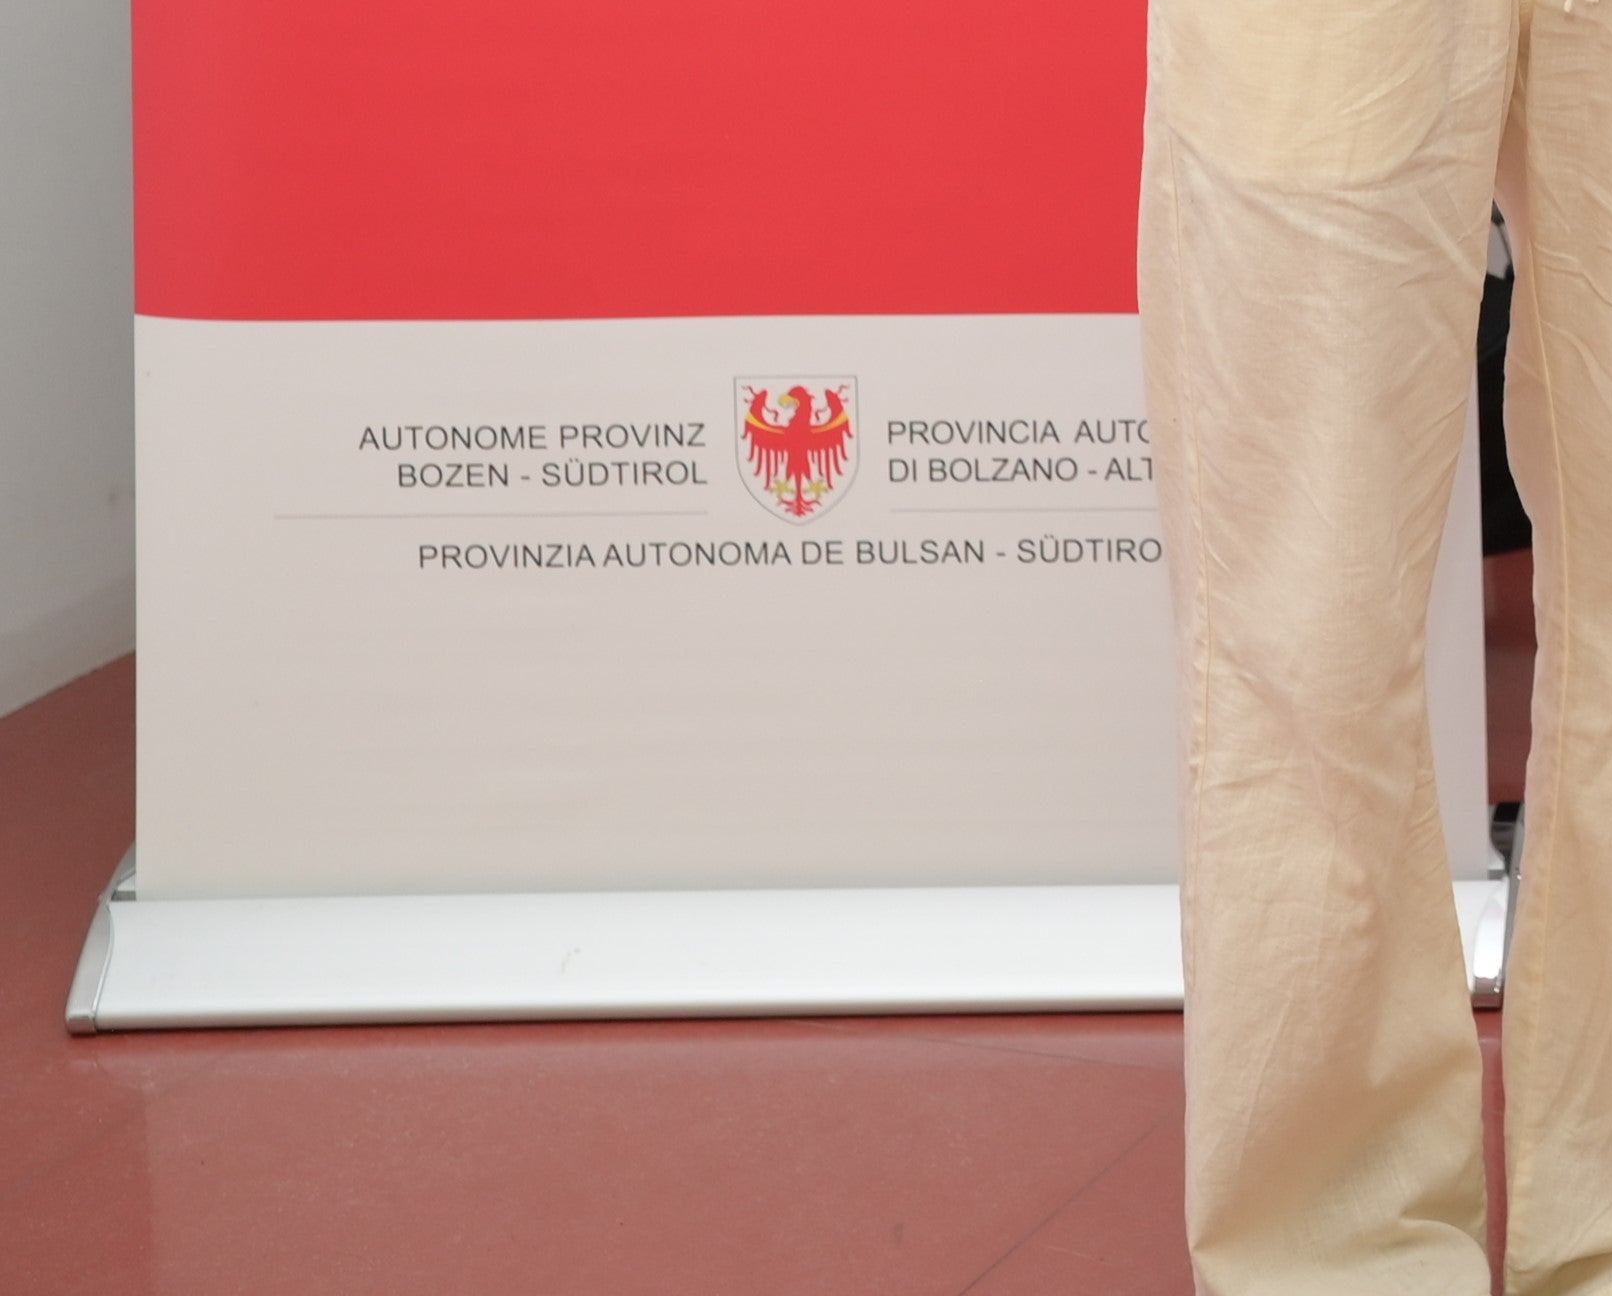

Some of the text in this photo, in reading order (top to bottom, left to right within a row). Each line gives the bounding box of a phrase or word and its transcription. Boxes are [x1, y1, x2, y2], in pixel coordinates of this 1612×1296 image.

[359, 423, 706, 451] AUTONOME PROVINZ
[888, 419, 1060, 445] PROVINCIA
[399, 463, 509, 488] BOZEN
[541, 458, 708, 486] SÜDTIROL
[889, 458, 917, 482] DI
[928, 457, 1078, 482] BOLZANO
[418, 544, 596, 569] PROVINZIA
[603, 541, 792, 568] AUTONOMA
[801, 540, 844, 565] DE
[856, 539, 985, 565] BULSAN
[1017, 535, 1163, 564] SÜDTIRO
